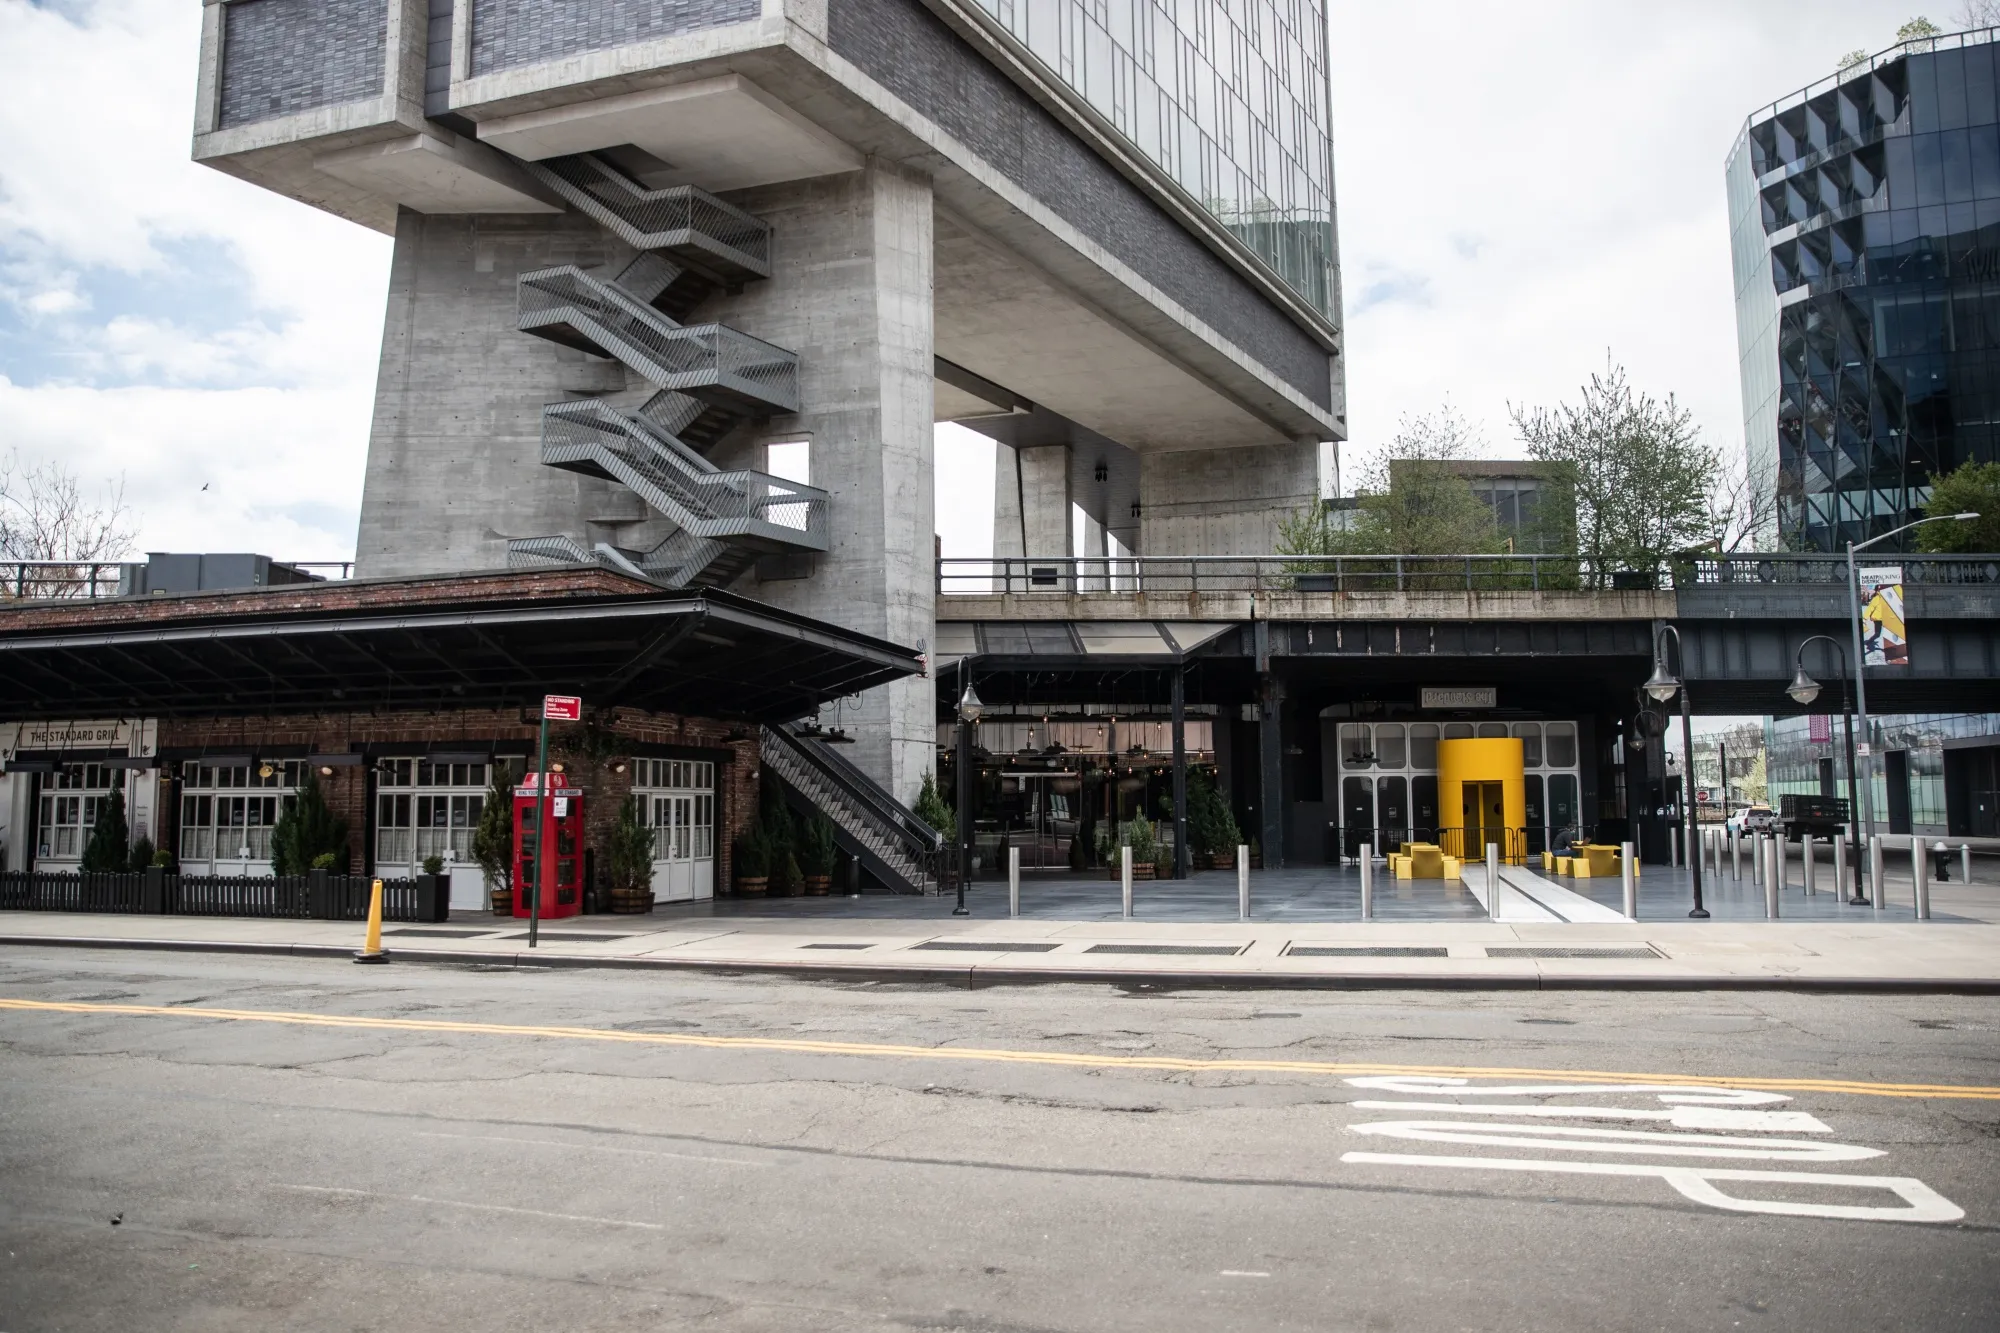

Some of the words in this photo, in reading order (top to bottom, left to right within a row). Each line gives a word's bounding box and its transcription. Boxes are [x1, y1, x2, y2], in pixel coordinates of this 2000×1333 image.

[1424, 691, 1472, 704] Standard
[1476, 691, 1493, 704] The
[31, 731, 47, 742] THE
[49, 730, 93, 742] STANDARD
[97, 729, 119, 741] GRILL
